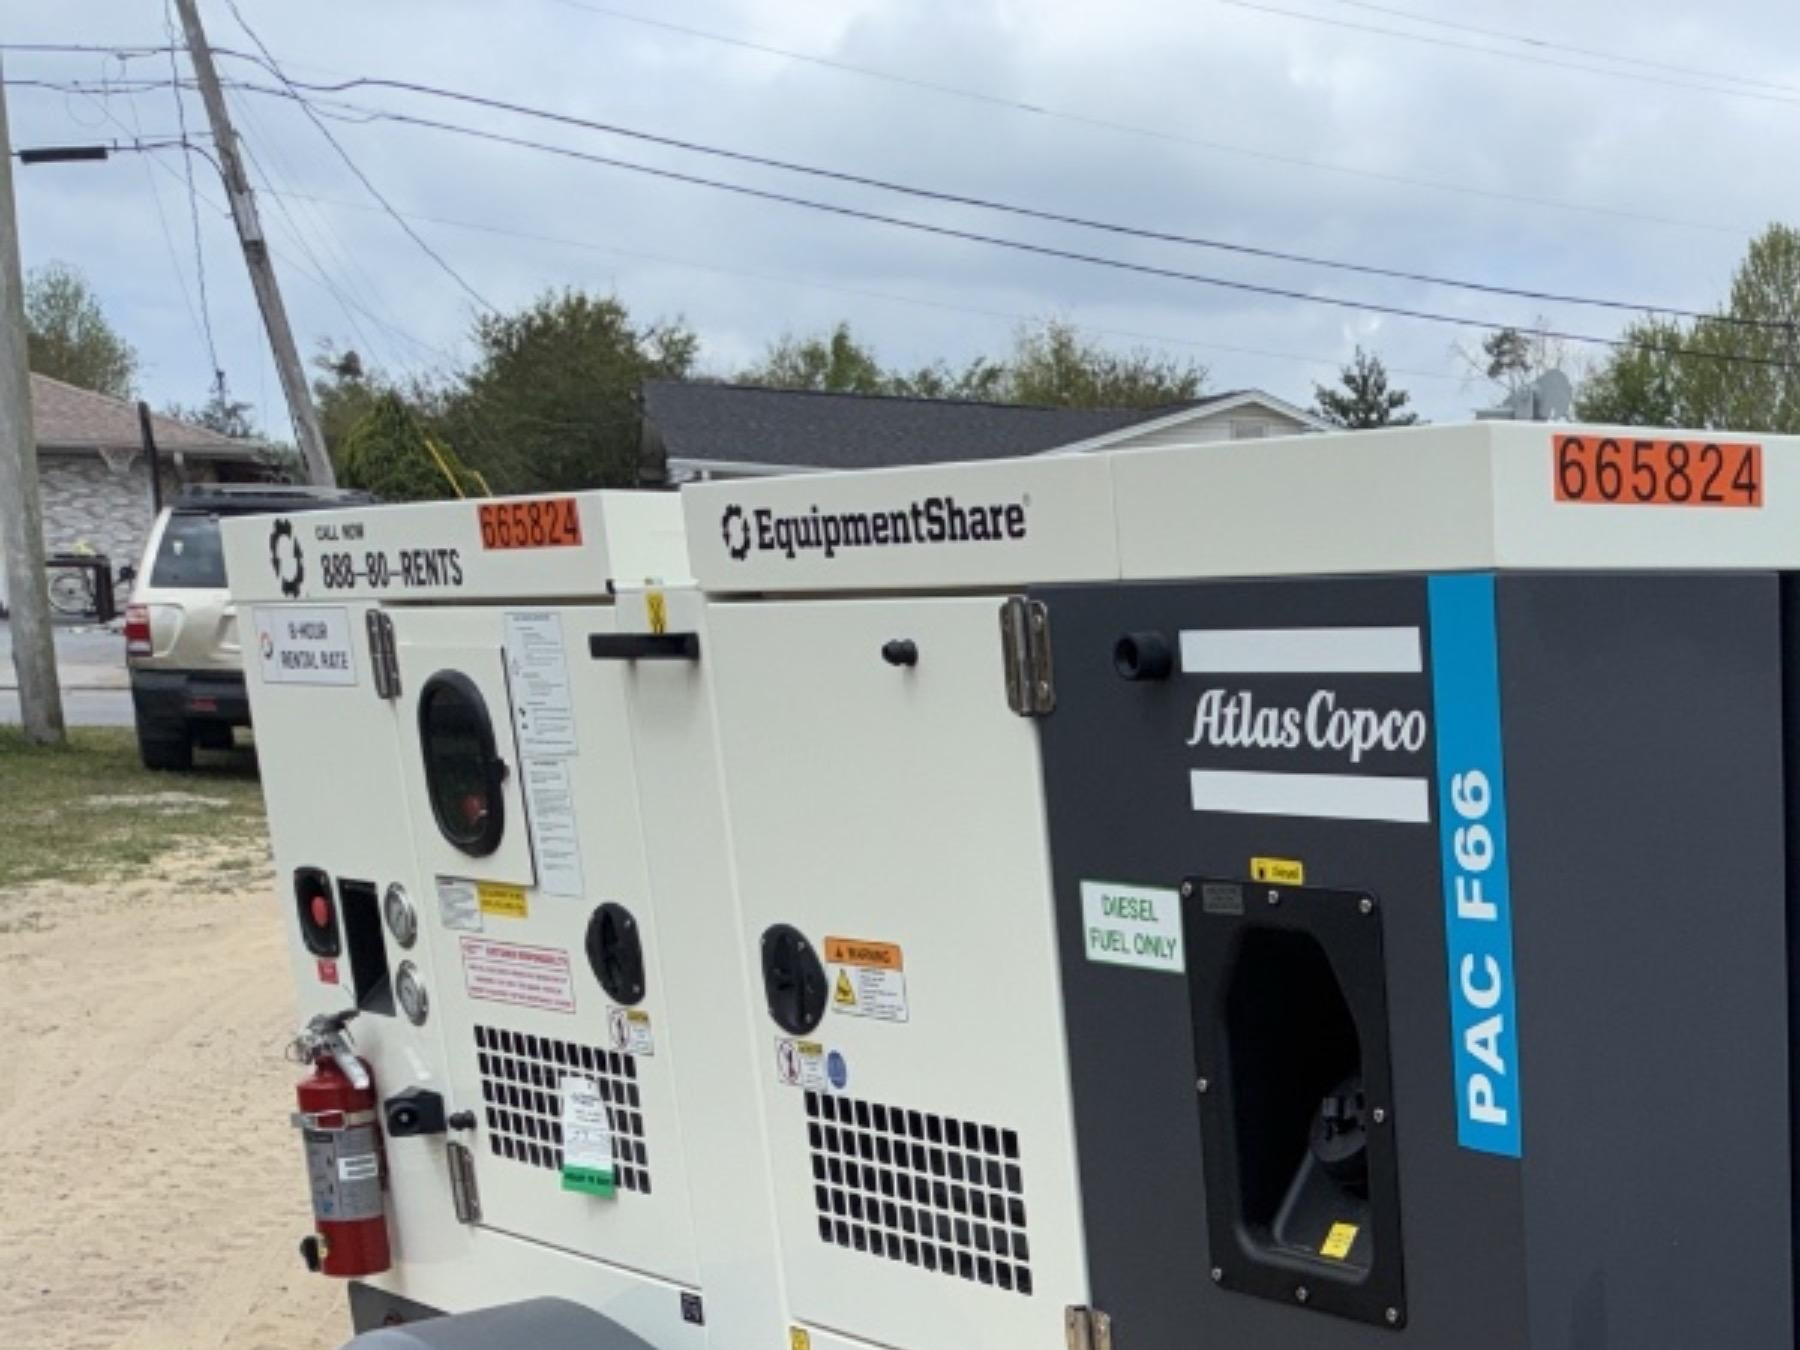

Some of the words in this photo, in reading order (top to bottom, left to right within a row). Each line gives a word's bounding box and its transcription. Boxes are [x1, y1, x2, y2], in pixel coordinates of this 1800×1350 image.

[1558, 436, 1757, 504] 665824
[315, 524, 339, 541] CALL
[342, 523, 364, 540] NOW
[481, 499, 578, 549] 665824
[754, 497, 1027, 558] EquipmentShare
[321, 549, 463, 589] 888-80-RENTS
[1186, 689, 1301, 748] Atlas
[1304, 690, 1426, 762] Copco
[1451, 769, 1498, 921] F66
[1101, 894, 1159, 922] DIESEL
[1088, 926, 1131, 955] FUEL
[1134, 932, 1177, 960] ONLY
[1460, 953, 1507, 1126] PAC
